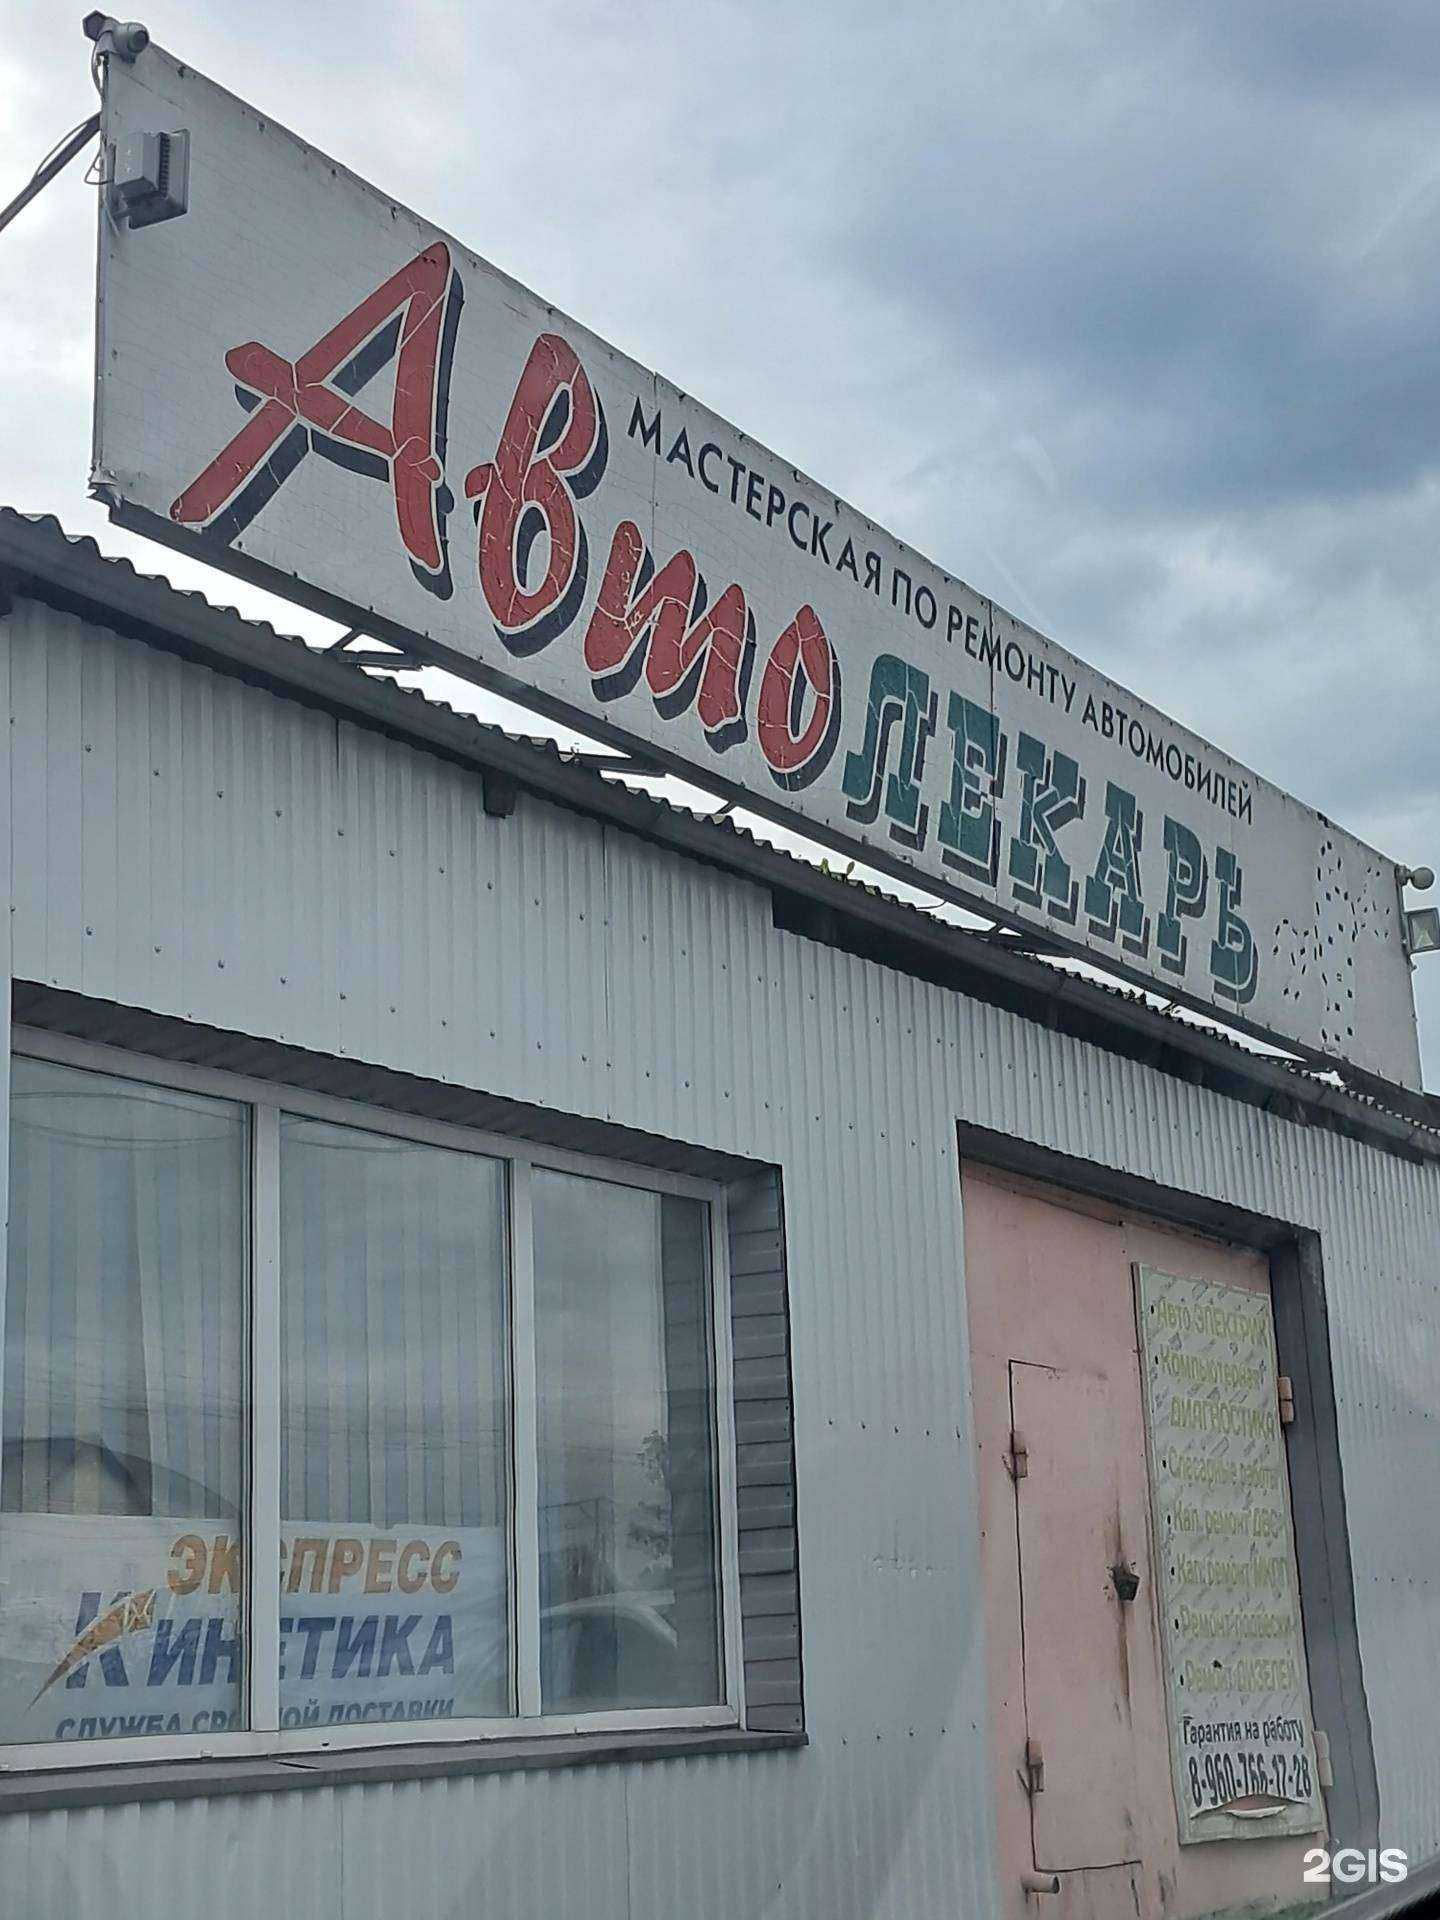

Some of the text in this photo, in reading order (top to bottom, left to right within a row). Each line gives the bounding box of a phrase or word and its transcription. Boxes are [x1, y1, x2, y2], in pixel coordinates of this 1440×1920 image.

[627, 396, 1253, 826] МАСТЕРСКАЯ ПО РЕМОНТУ АВТОМОБИЛЕЙ
[166, 1534, 463, 1595] ЭКПРЕСС
[1182, 1715, 1304, 1748] Гарантия на работу
